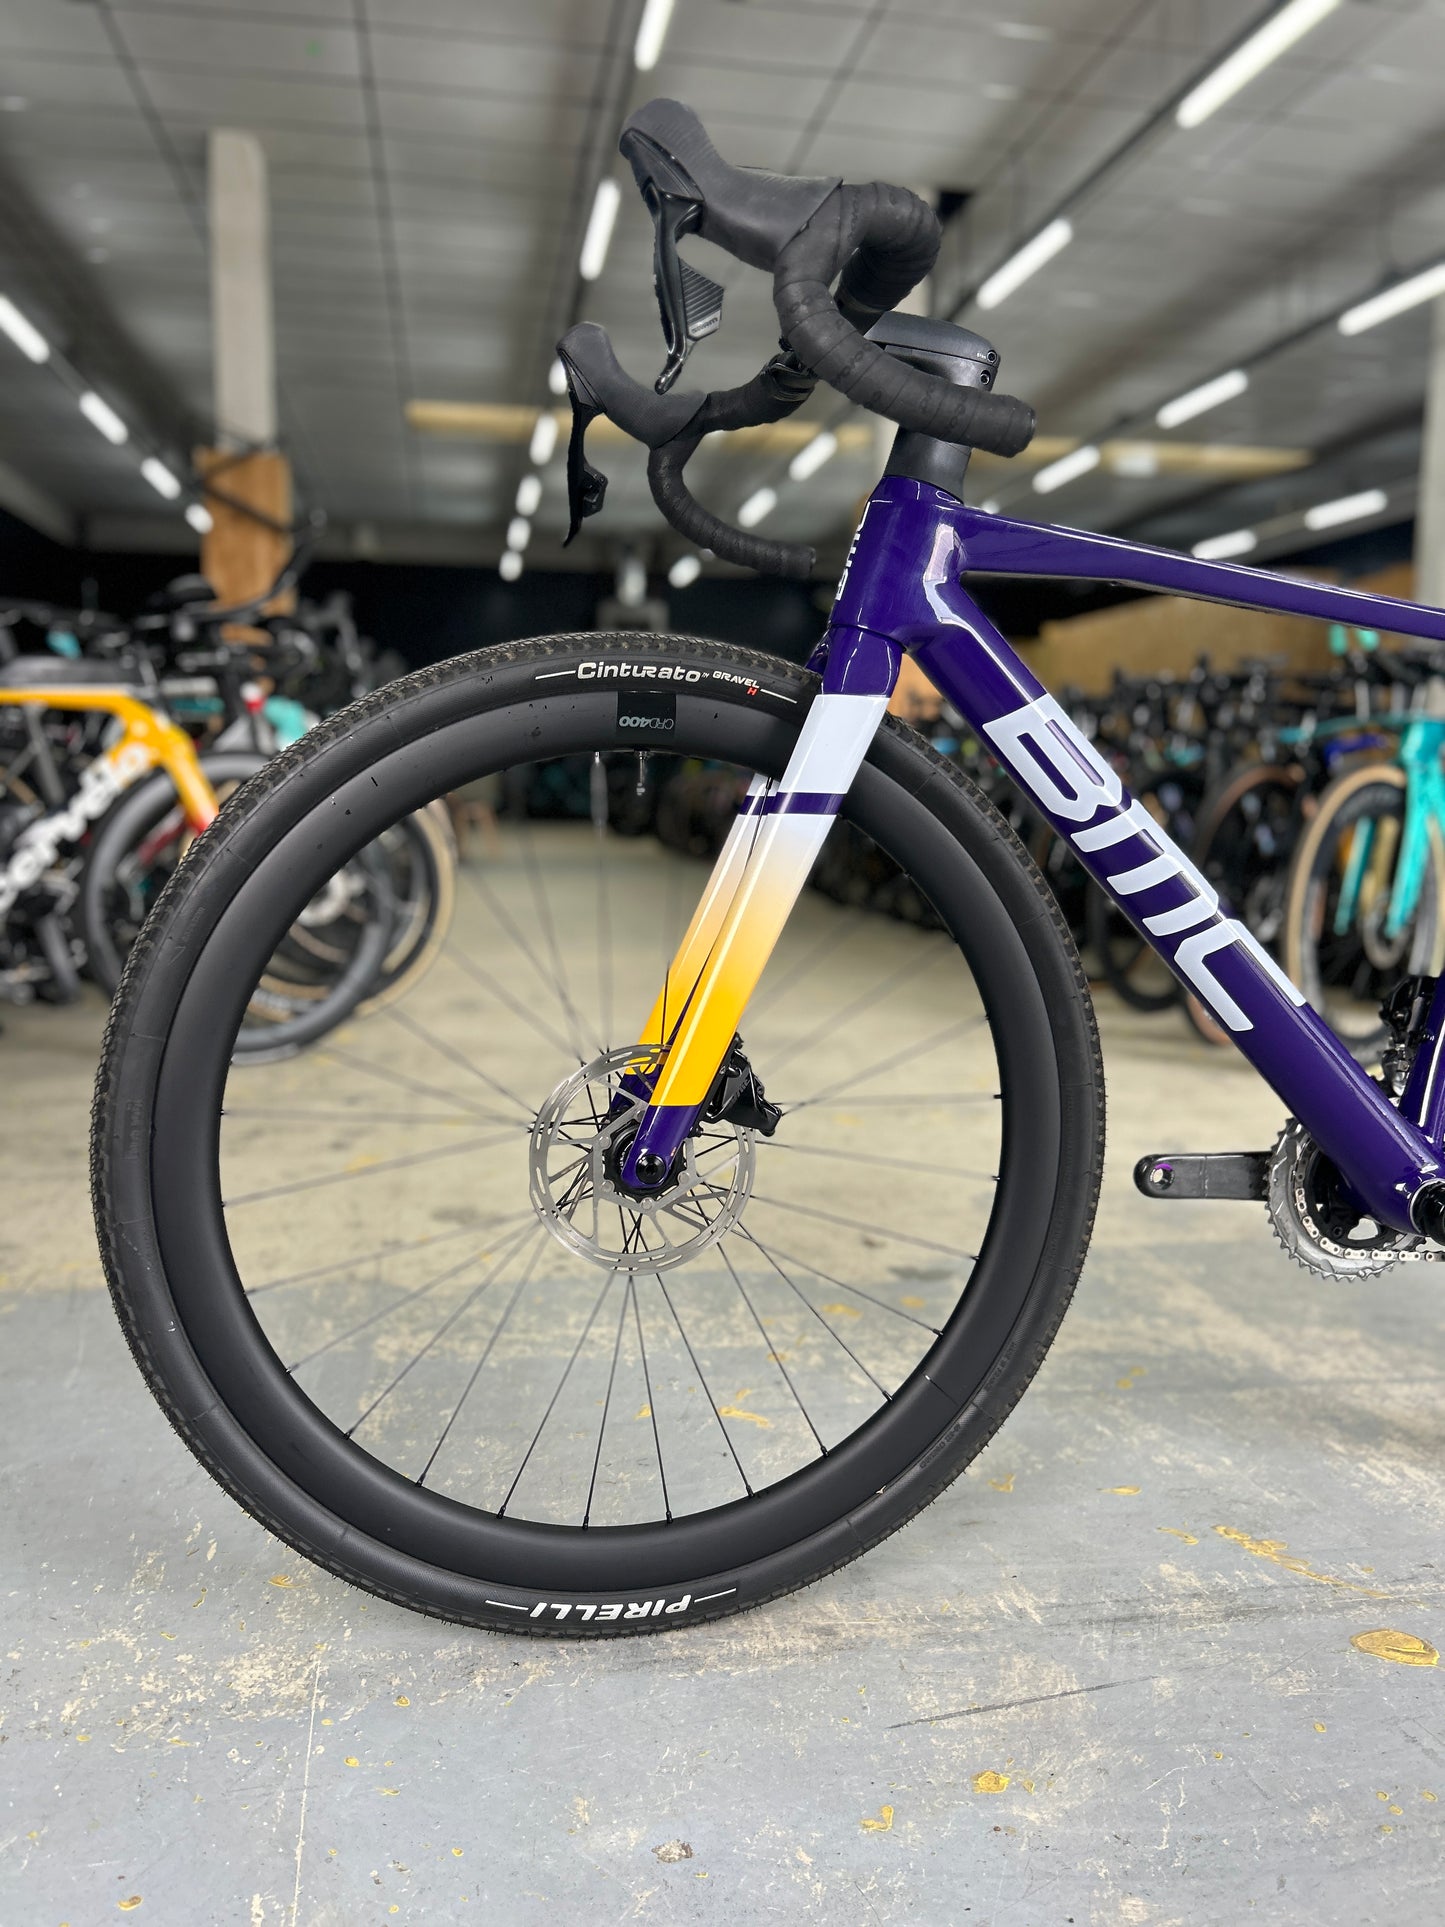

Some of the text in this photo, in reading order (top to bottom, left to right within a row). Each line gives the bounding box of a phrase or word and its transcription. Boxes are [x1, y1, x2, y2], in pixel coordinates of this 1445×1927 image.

[577, 661, 760, 689] Cinturato GRAVEL
[983, 692, 1306, 1032] BMC
[530, 1594, 692, 1621] PIRELLI
